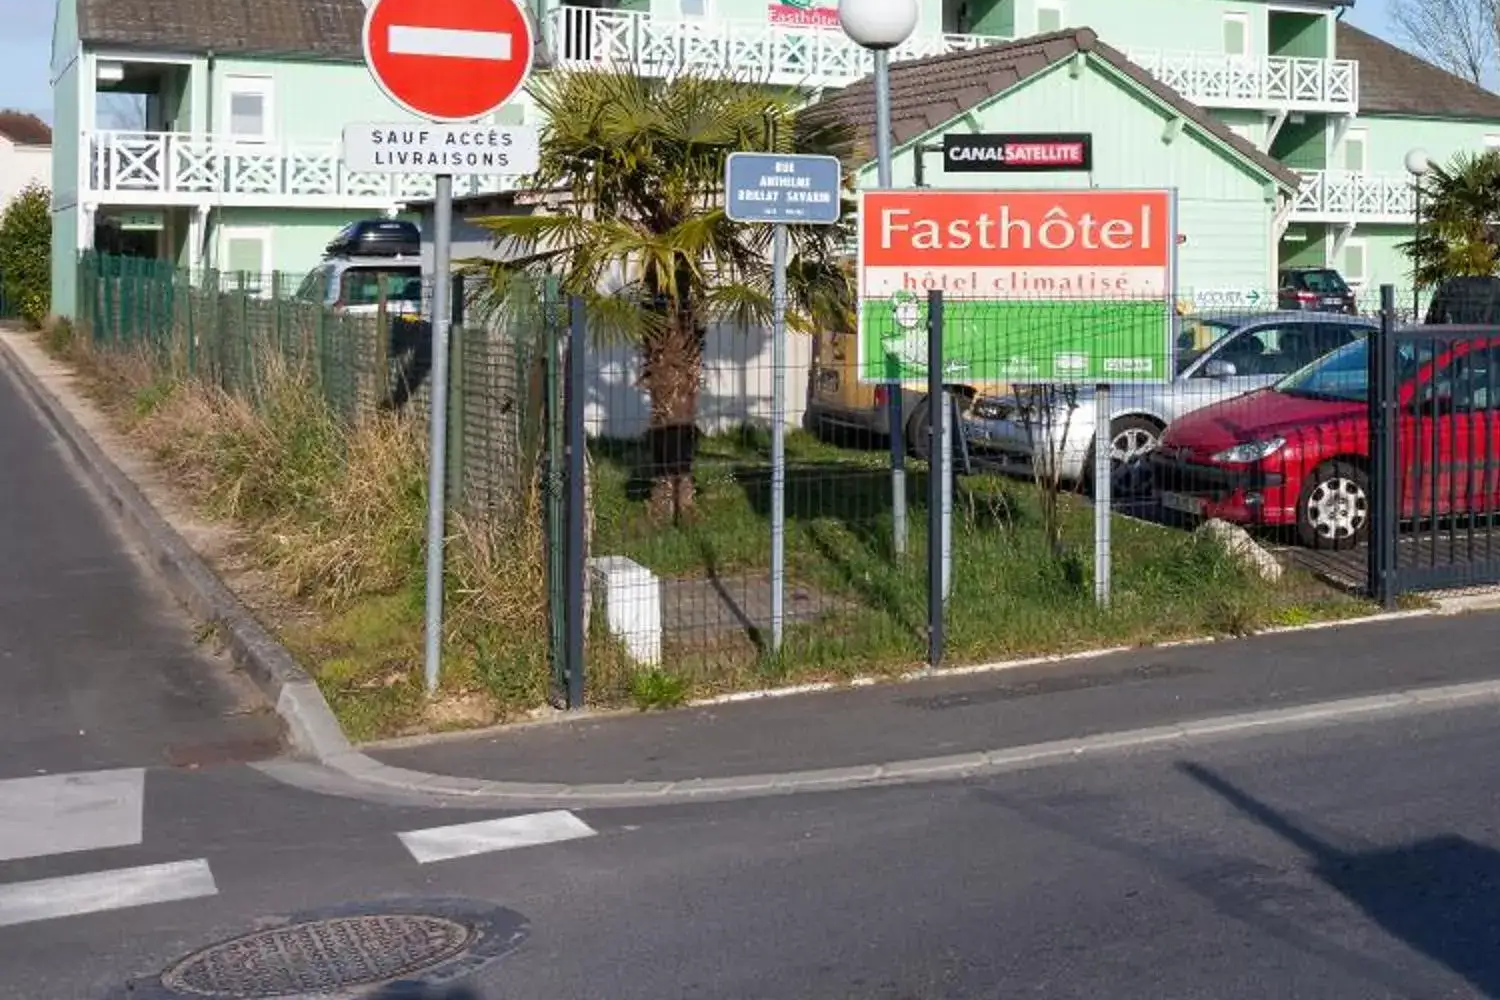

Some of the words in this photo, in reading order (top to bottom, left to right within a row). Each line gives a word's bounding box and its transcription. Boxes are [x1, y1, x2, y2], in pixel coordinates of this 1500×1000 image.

[372, 130, 429, 144] SAUF
[445, 129, 513, 146] ACCÈS
[375, 151, 509, 167] LIVRAISONS
[775, 162, 795, 173] RUE
[880, 204, 1151, 250] Fasthôtel
[903, 271, 978, 291] hôtel
[992, 271, 1130, 291] climatisé
